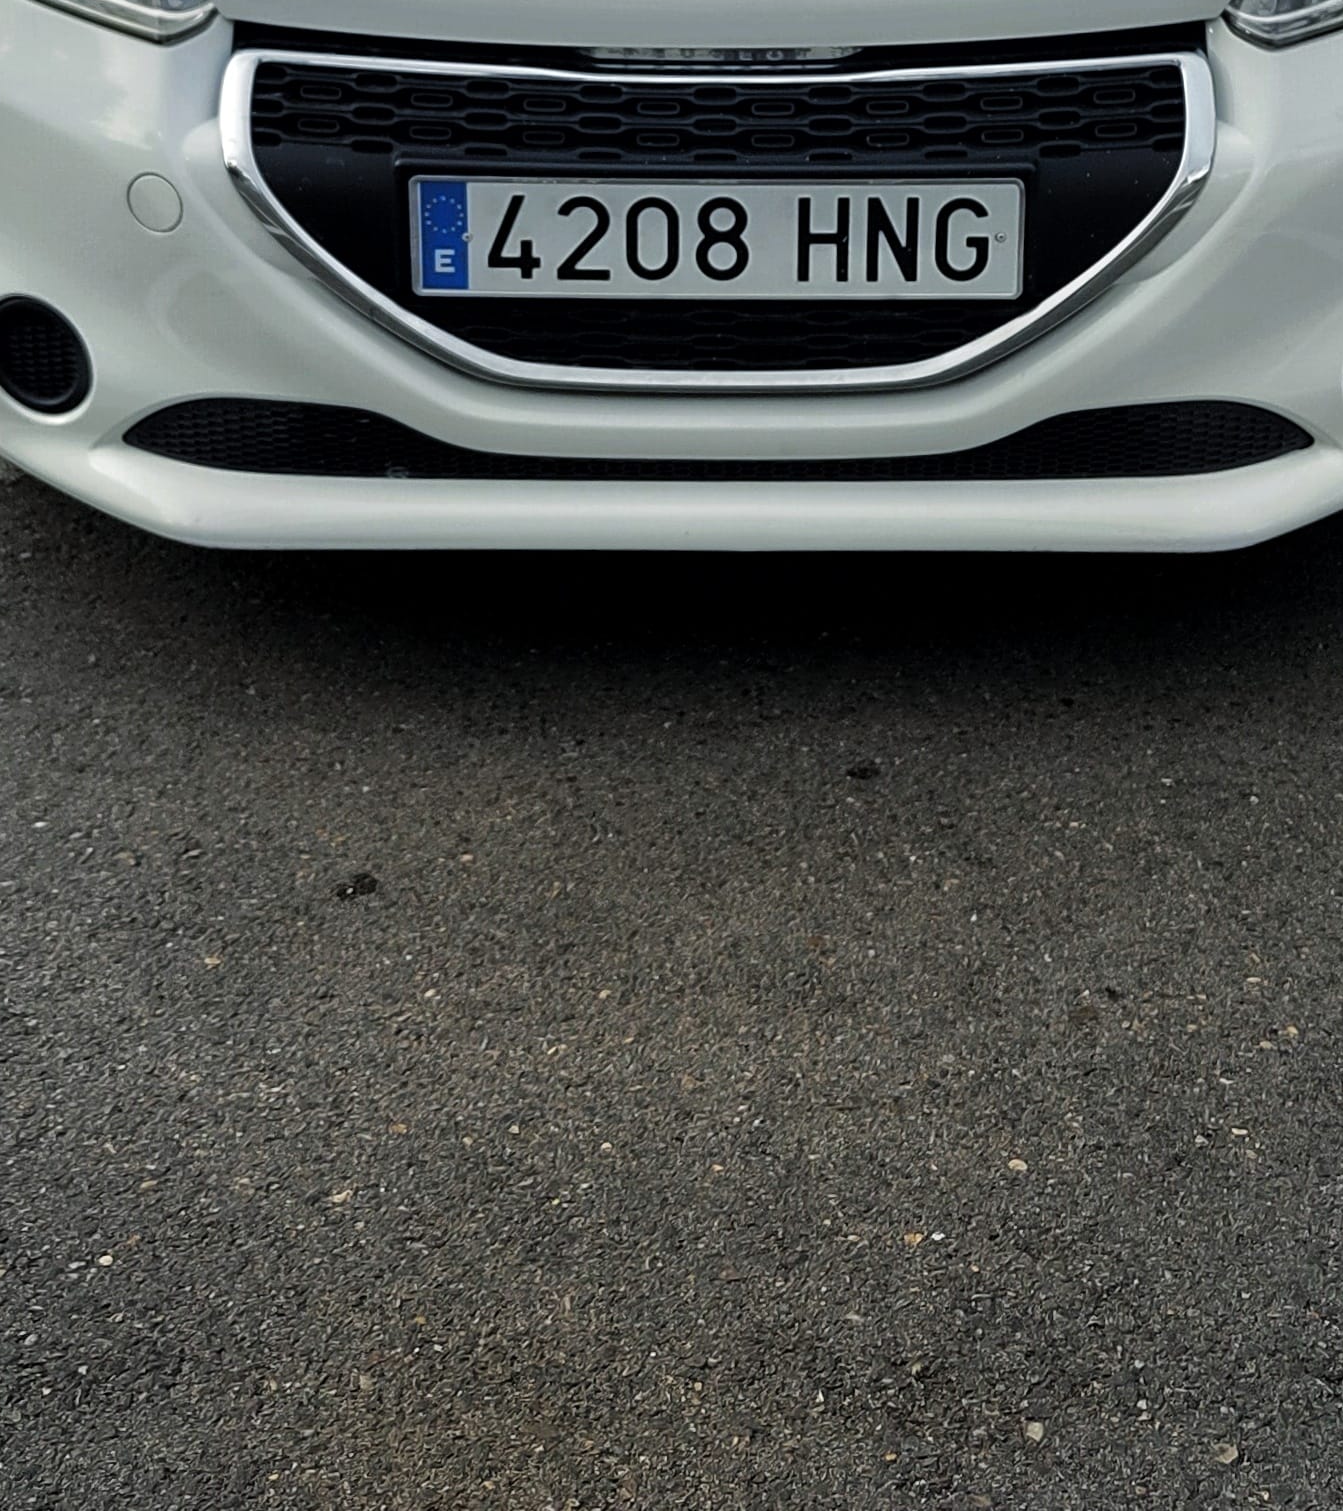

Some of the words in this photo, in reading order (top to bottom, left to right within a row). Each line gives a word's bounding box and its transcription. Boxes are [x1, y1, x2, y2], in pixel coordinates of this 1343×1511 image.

[434, 248, 455, 274] E
[487, 194, 750, 282] 4208
[797, 196, 990, 283] HNG
